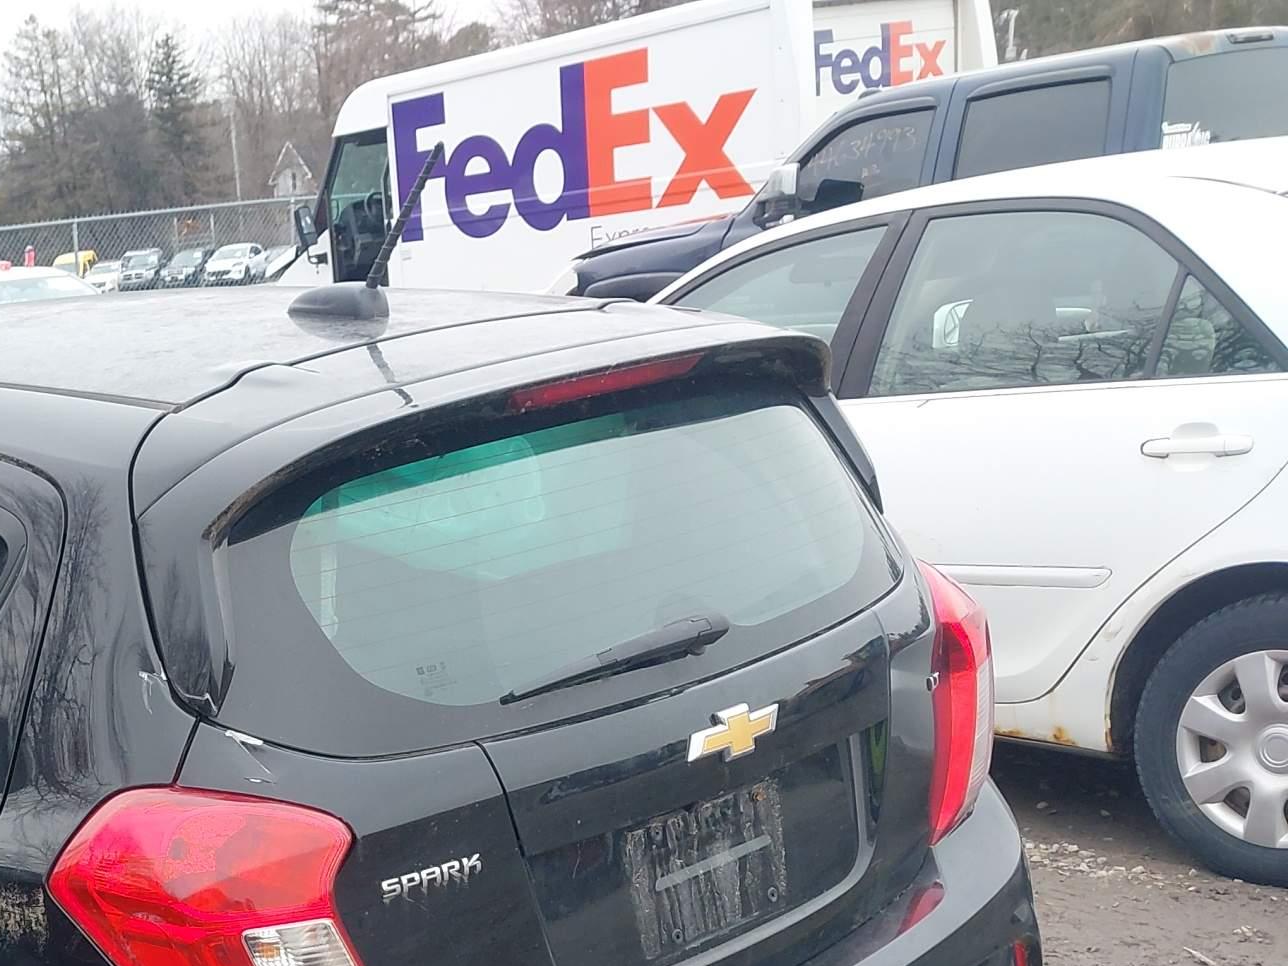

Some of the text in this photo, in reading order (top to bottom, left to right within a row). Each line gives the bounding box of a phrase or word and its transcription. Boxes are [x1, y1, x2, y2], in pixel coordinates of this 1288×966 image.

[813, 20, 947, 97] FedEx
[391, 47, 758, 243] FedEx
[381, 853, 482, 899] SPARK
